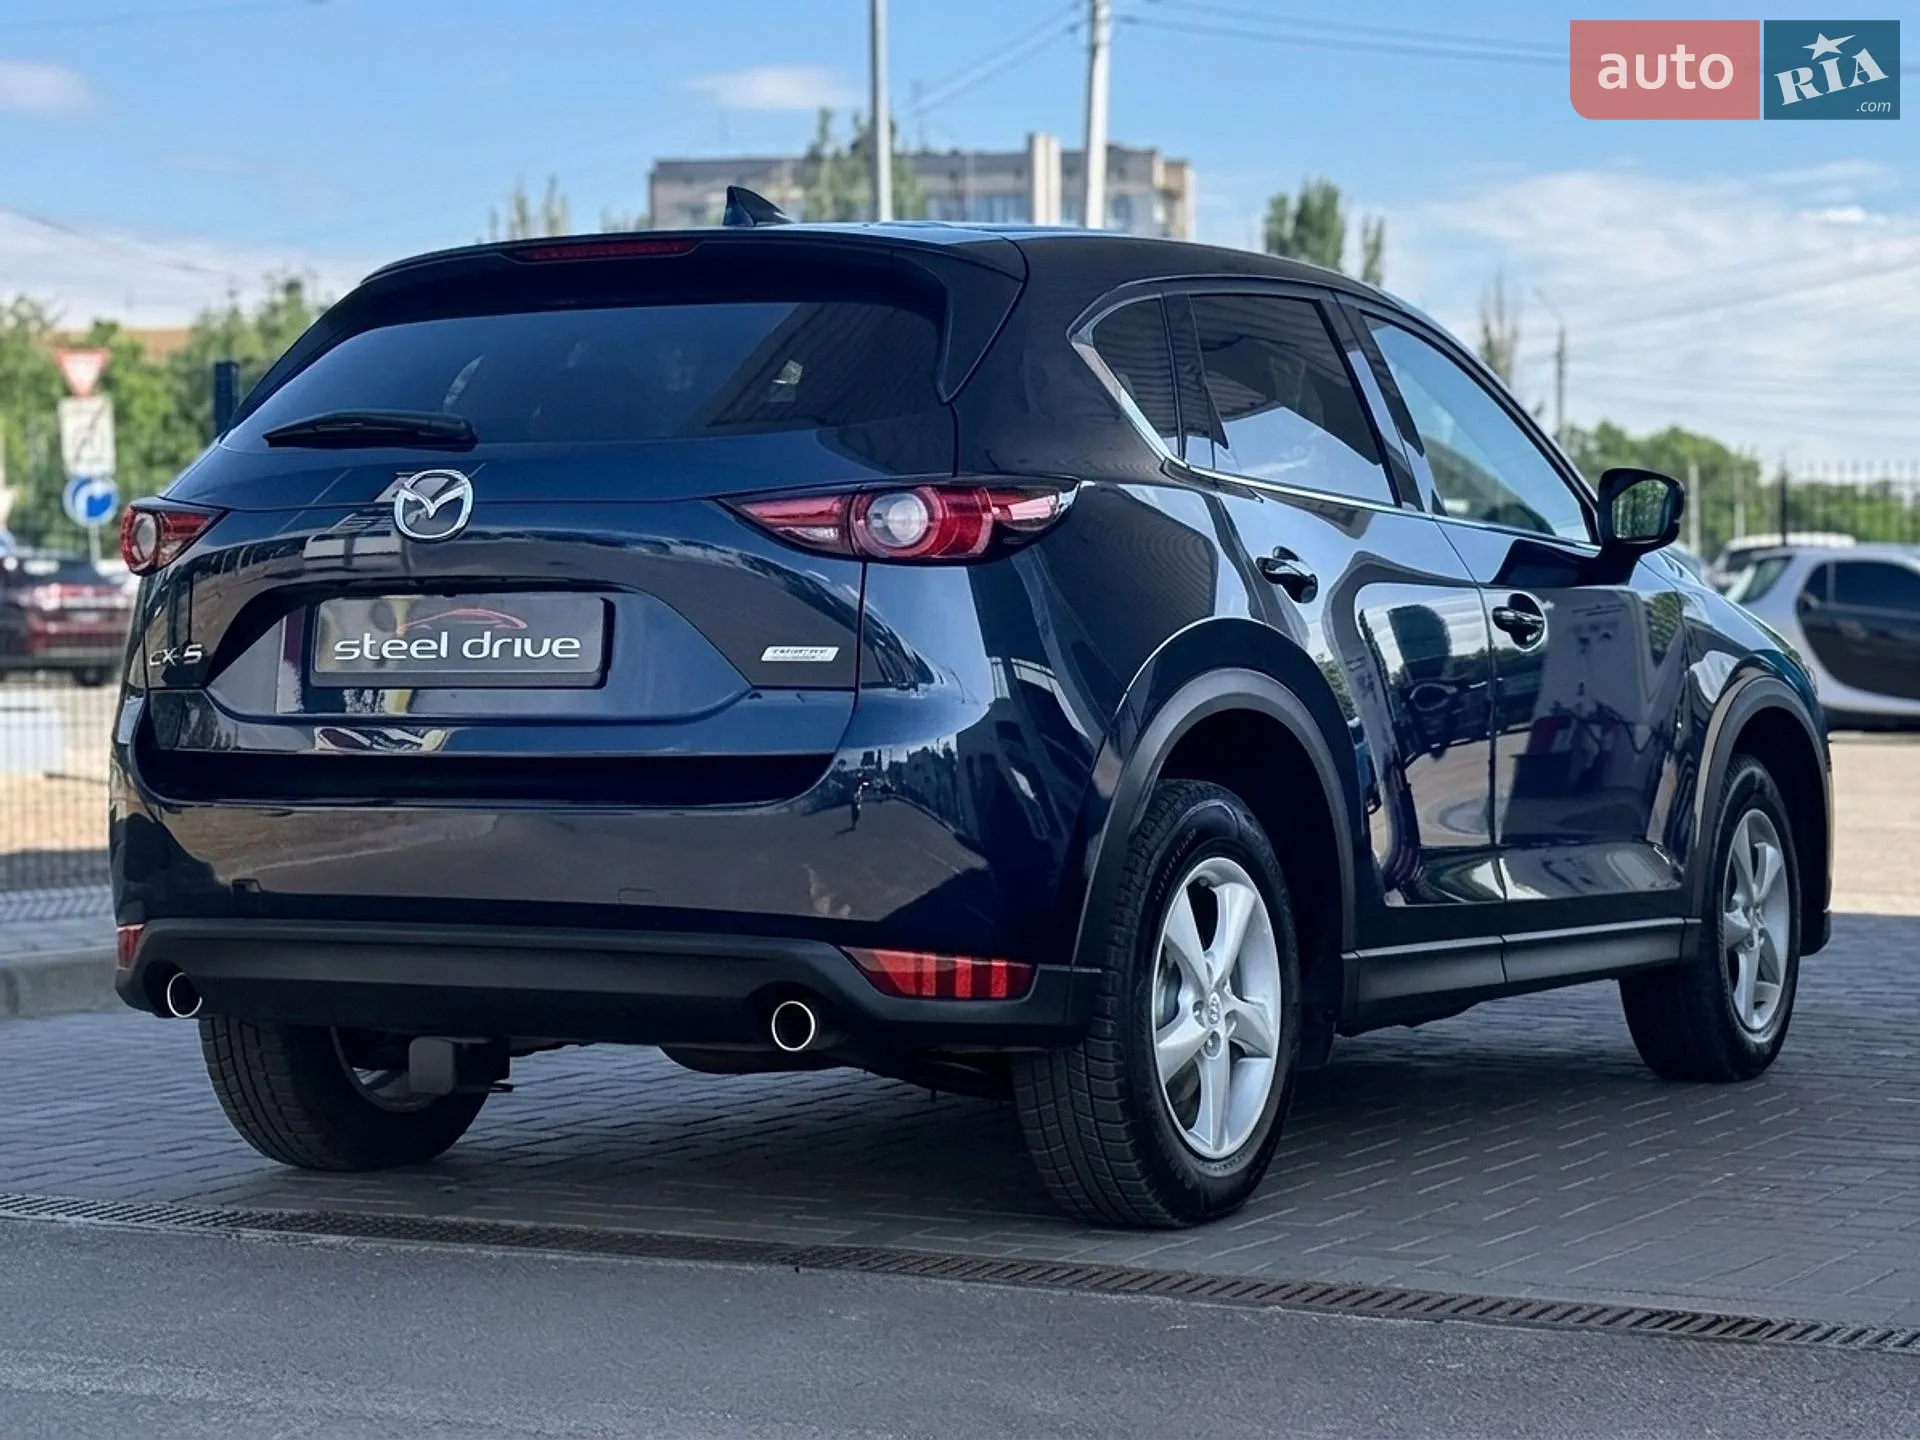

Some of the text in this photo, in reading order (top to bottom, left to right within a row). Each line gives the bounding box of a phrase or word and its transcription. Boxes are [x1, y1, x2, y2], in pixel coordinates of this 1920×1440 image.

[149, 643, 203, 666] CX-5
[334, 631, 581, 660] steel drive
